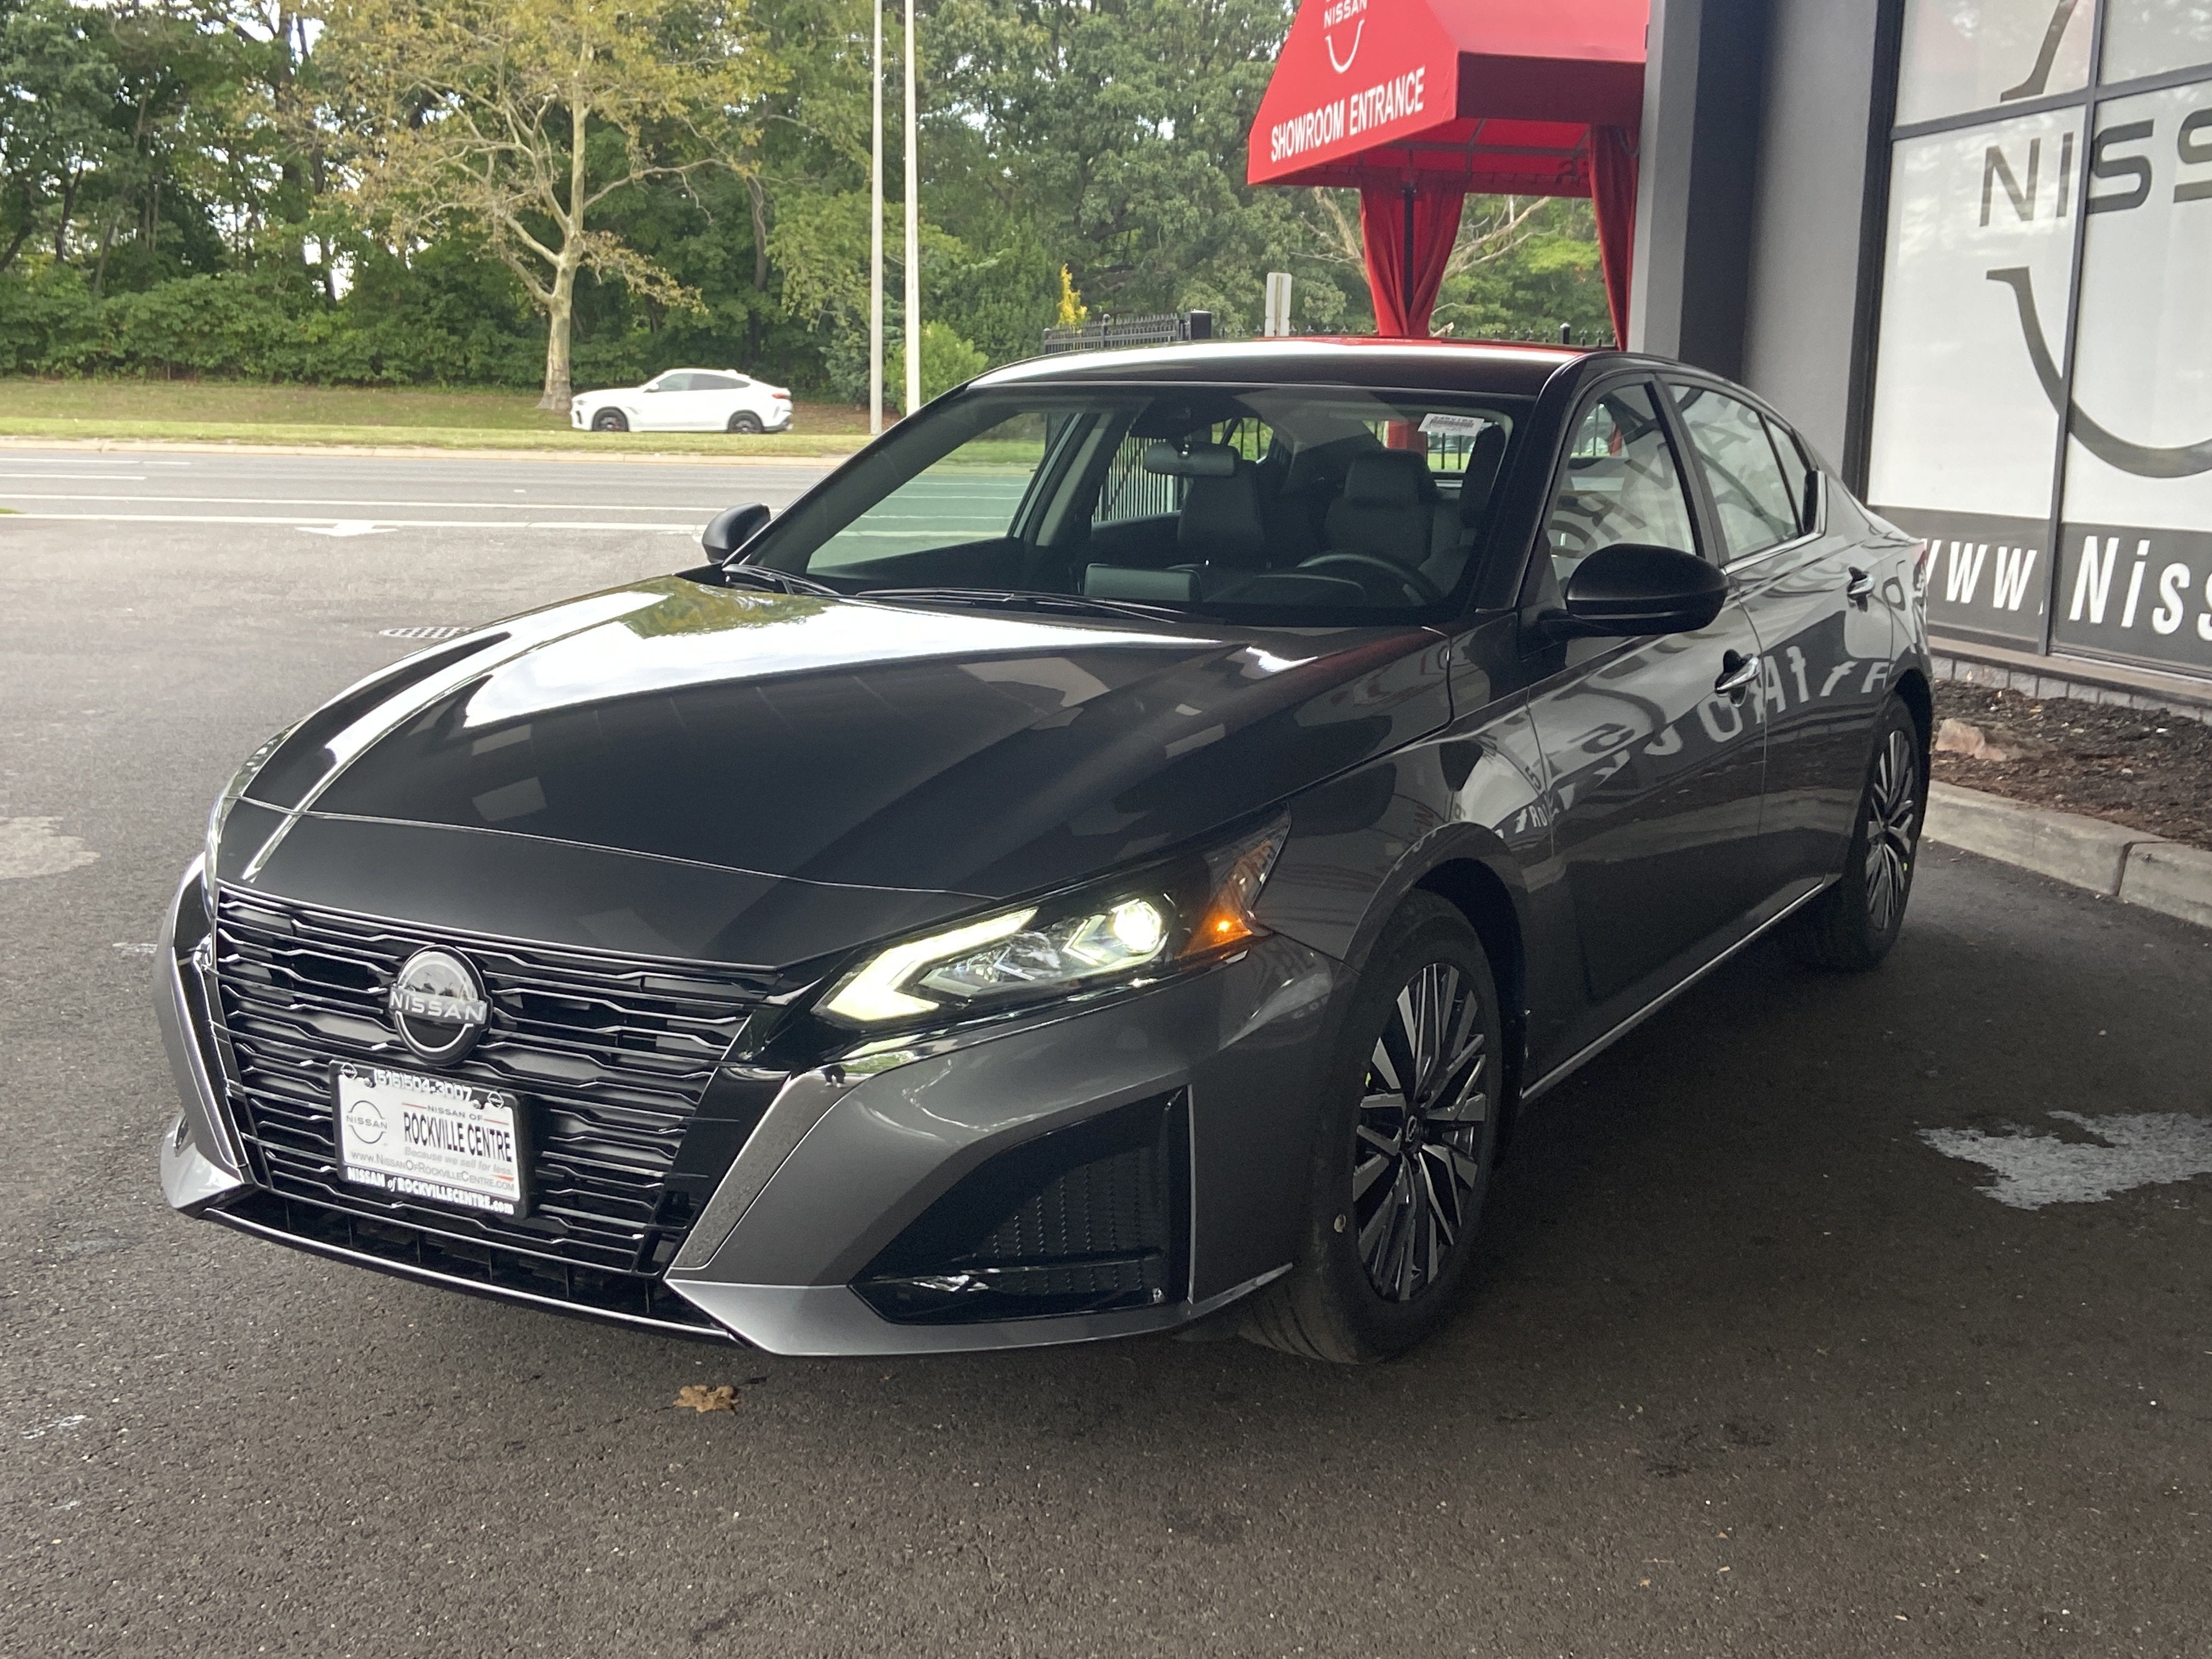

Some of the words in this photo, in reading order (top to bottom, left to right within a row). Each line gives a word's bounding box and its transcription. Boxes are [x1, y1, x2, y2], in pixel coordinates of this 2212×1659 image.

[1271, 99, 1345, 162] SHOWROOM
[1349, 65, 1425, 136] ENTRANCE
[391, 991, 484, 1021] NISSAN
[346, 1115, 387, 1129] NISSAN
[427, 1105, 465, 1118] NISSAN
[403, 1111, 465, 1153] ROCKVILLE
[467, 1123, 512, 1163] CENTRE
[405, 1147, 442, 1162] Because
[445, 1156, 458, 1165] we
[460, 1159, 476, 1168] sell
[478, 1160, 491, 1171] for
[347, 1166, 385, 1187] NISSAN
[387, 1177, 397, 1192] of
